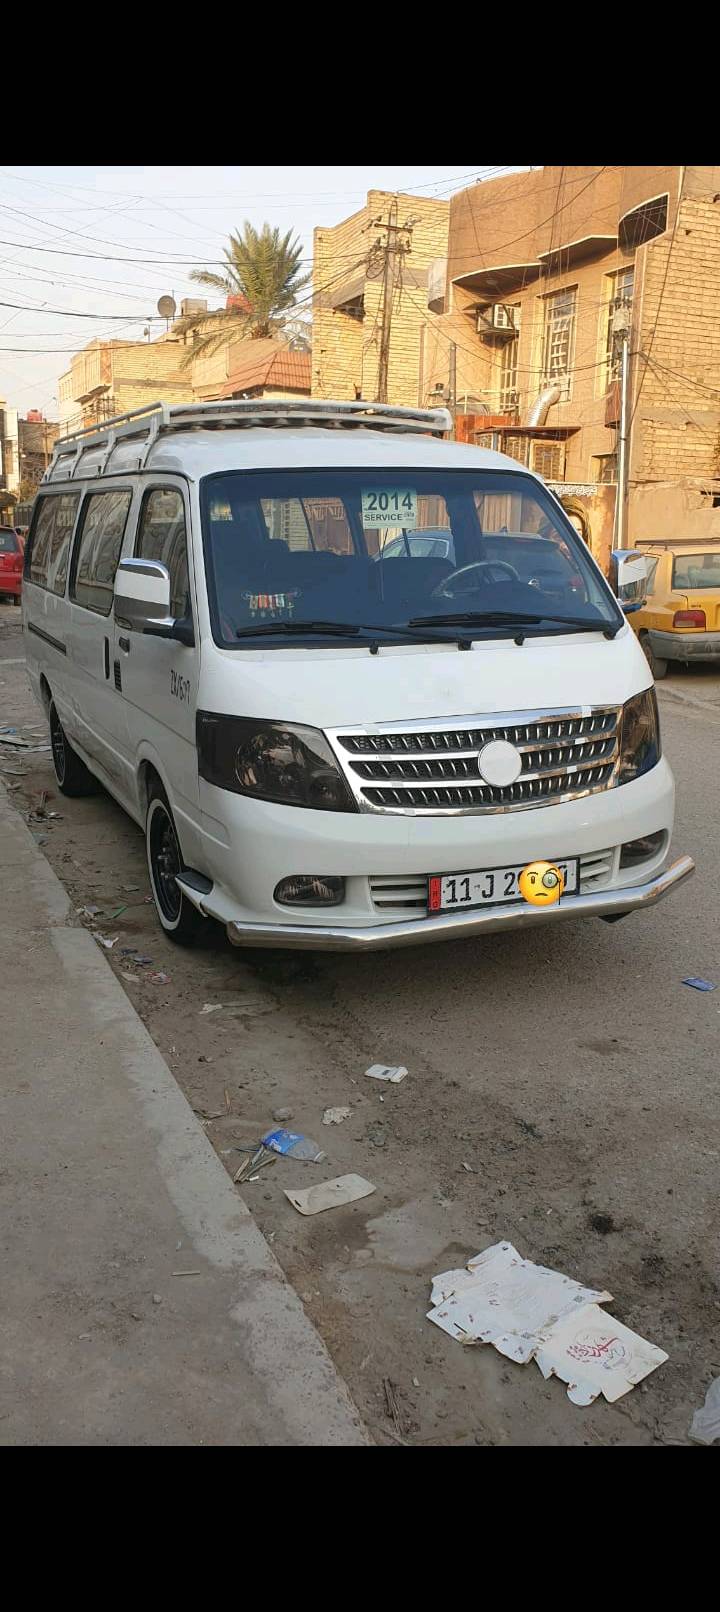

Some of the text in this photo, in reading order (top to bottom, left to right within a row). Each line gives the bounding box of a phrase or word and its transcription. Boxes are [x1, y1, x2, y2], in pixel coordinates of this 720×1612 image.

[367, 491, 413, 511] 2014
[364, 513, 403, 521] SERVICE
[446, 877, 472, 903] 11
[482, 874, 495, 899] J
